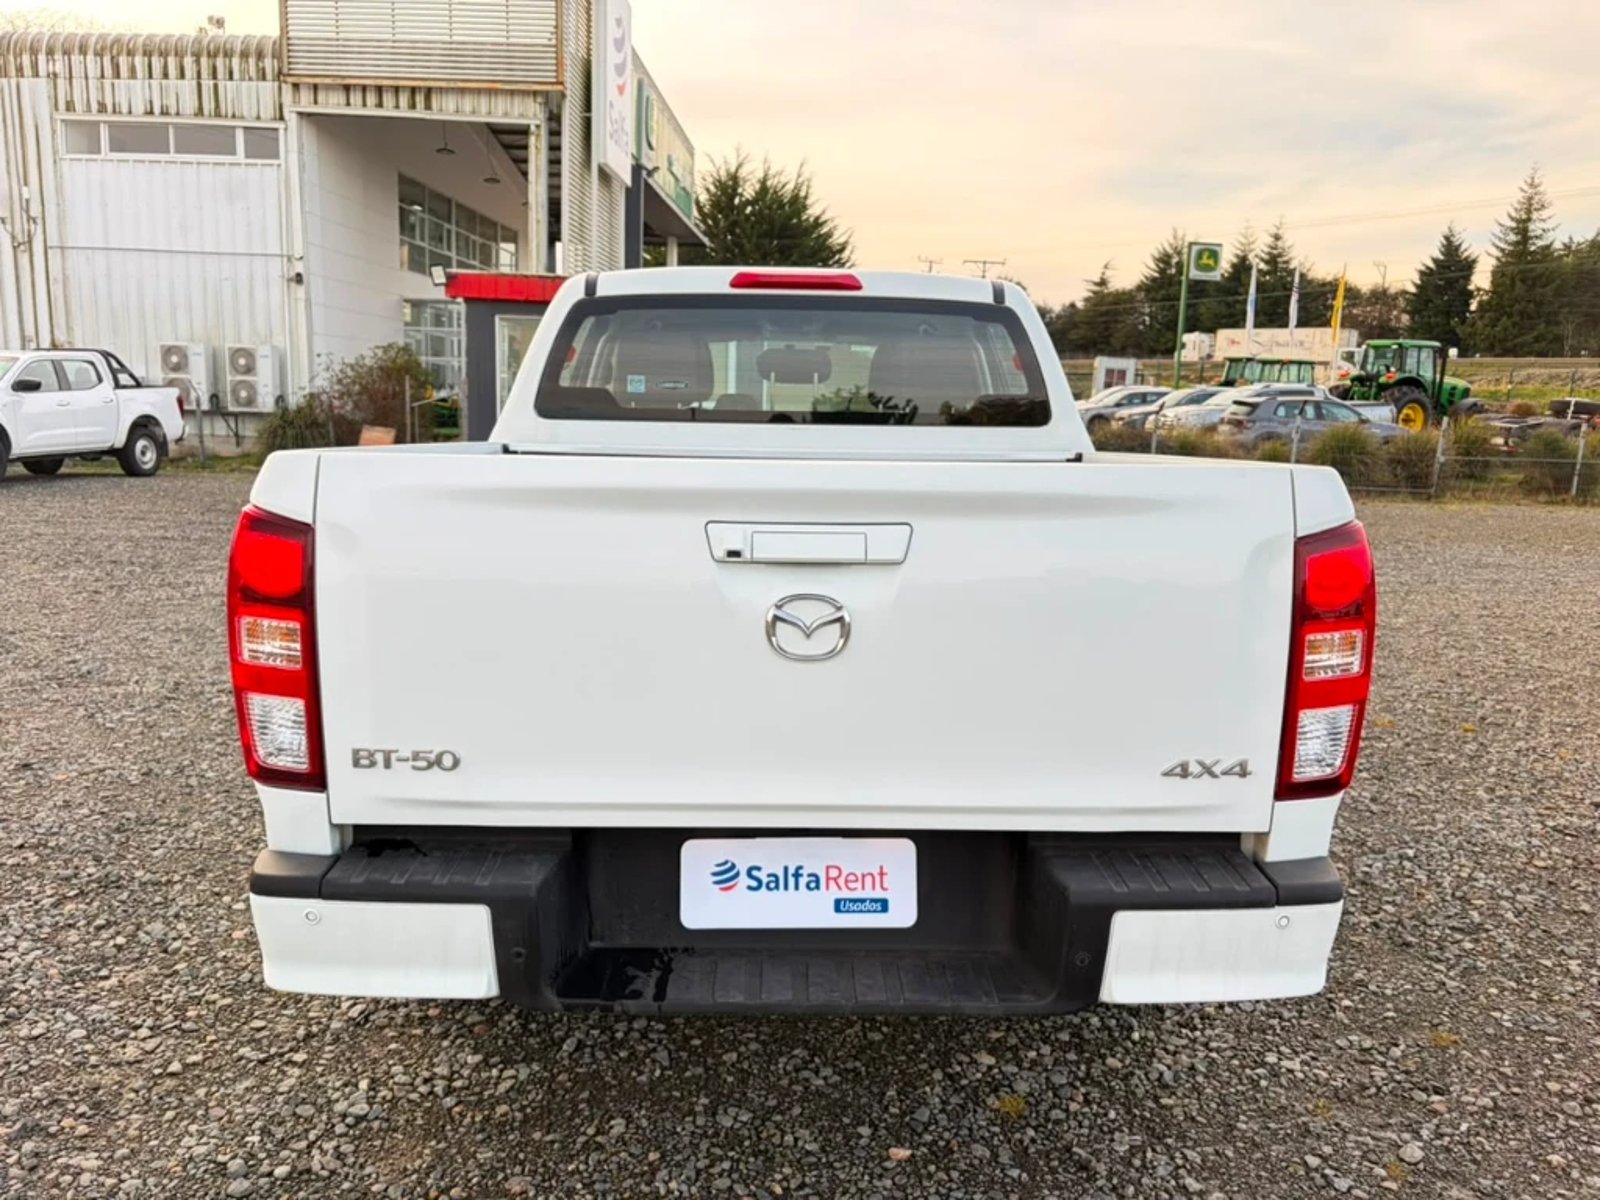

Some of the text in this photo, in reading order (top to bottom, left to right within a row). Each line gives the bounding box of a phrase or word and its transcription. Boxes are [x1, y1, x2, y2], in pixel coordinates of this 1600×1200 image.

[351, 747, 461, 772] BT-50
[1160, 759, 1252, 779] 4X4
[838, 900, 883, 912] Usados
